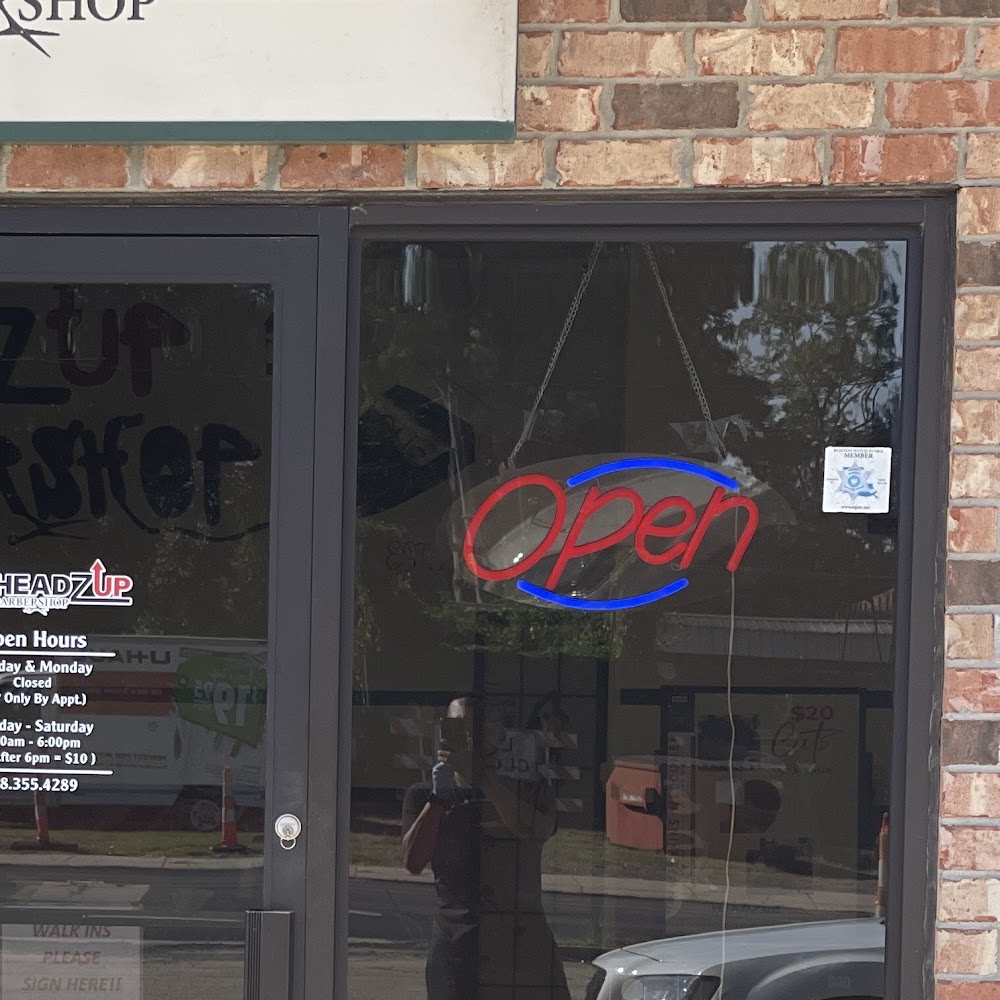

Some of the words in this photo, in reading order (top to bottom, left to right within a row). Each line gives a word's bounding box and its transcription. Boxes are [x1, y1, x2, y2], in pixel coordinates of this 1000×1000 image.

[463, 473, 760, 591] Open
[34, 630, 87, 648] Hours
[25, 660, 35, 672] &
[38, 661, 93, 676] Monday
[13, 677, 51, 688] Closed
[4, 692, 31, 706] Only
[34, 693, 49, 706] By
[52, 693, 86, 707] Appt.)
[791, 704, 834, 721] $20
[35, 720, 94, 735] Saturday
[37, 736, 80, 750] 6:00pm
[25, 752, 50, 765] 6pm
[65, 752, 87, 764] $10
[32, 924, 78, 938] WALK
[84, 924, 112, 938] INS
[41, 951, 102, 964] PLEASE
[21, 977, 62, 991] SIGN
[66, 977, 123, 991] HERE!!
